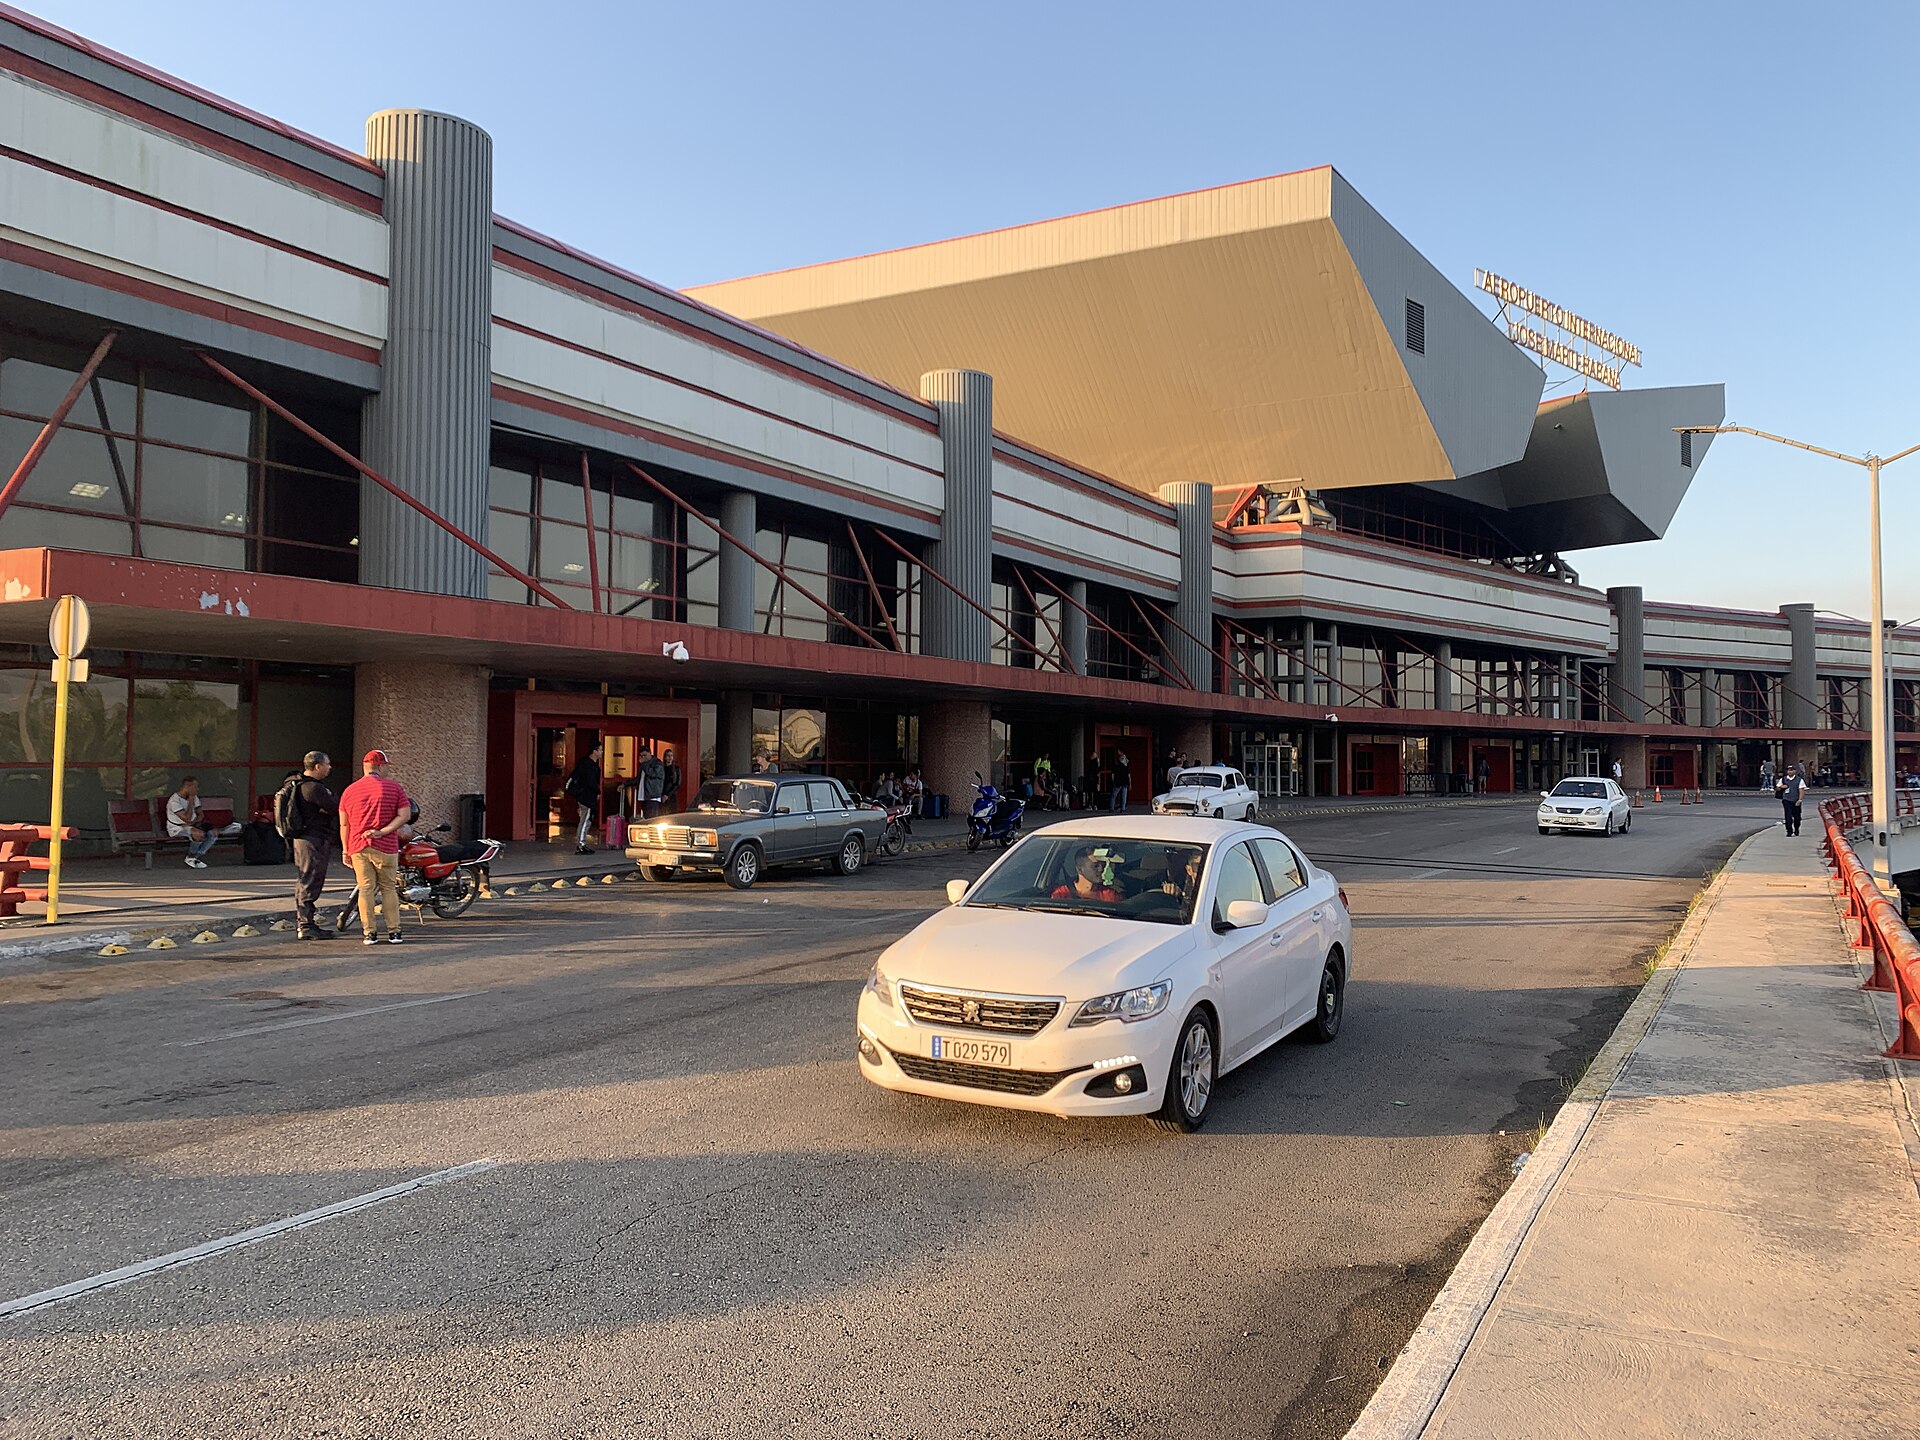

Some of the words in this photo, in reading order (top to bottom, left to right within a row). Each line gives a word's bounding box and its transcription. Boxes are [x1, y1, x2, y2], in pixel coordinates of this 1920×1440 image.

[1483, 270, 1564, 325] AEROPUERTO
[1564, 309, 1640, 367] INTERNACIONAL
[942, 1040, 950, 1057] T
[953, 1042, 978, 1060] 029
[982, 1044, 1008, 1063] 579
